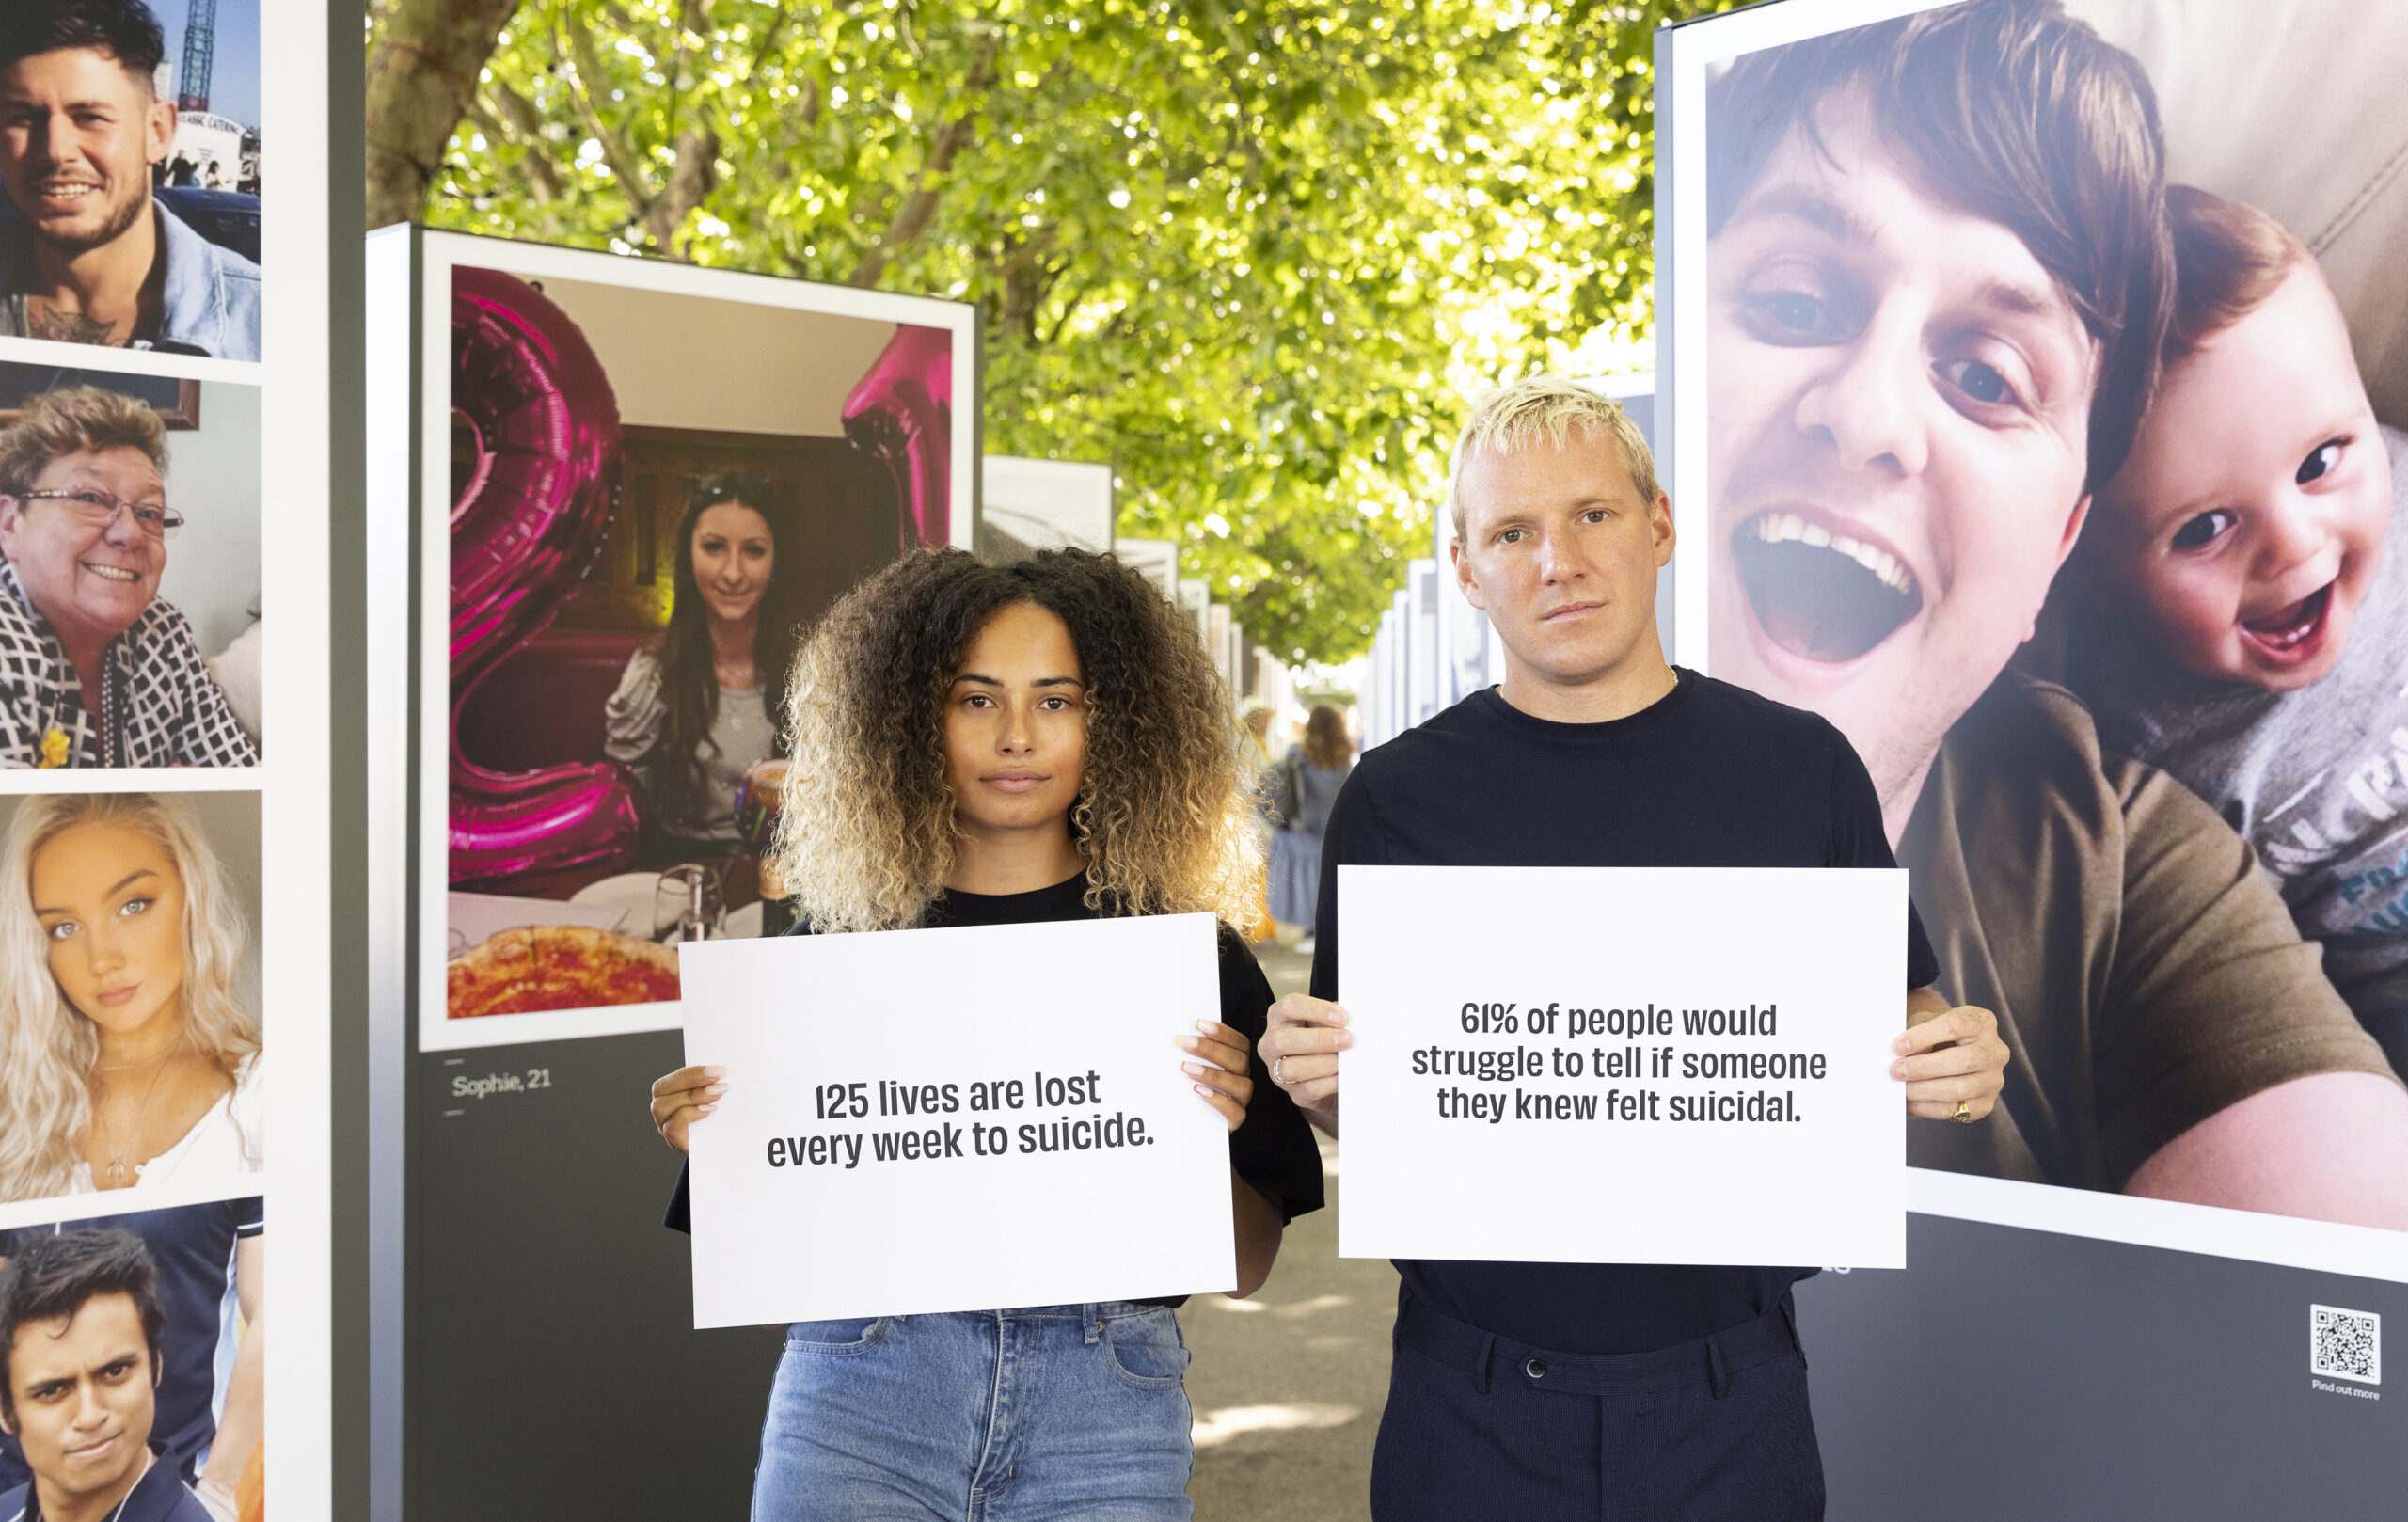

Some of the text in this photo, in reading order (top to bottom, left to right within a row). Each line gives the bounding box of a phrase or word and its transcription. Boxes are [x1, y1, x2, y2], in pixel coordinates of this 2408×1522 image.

[1461, 1002, 1777, 1040] 61% of people would
[1412, 1045, 1827, 1082] struggle to tell if someone
[452, 1069, 551, 1099] Sophie, 21
[816, 1070, 1101, 1119] 125 lives are lost
[1436, 1086, 1801, 1124] they knew felt suicidal.
[767, 1111, 1154, 1169] every week to suicide.
[2312, 1379, 2380, 1401] Find out more
